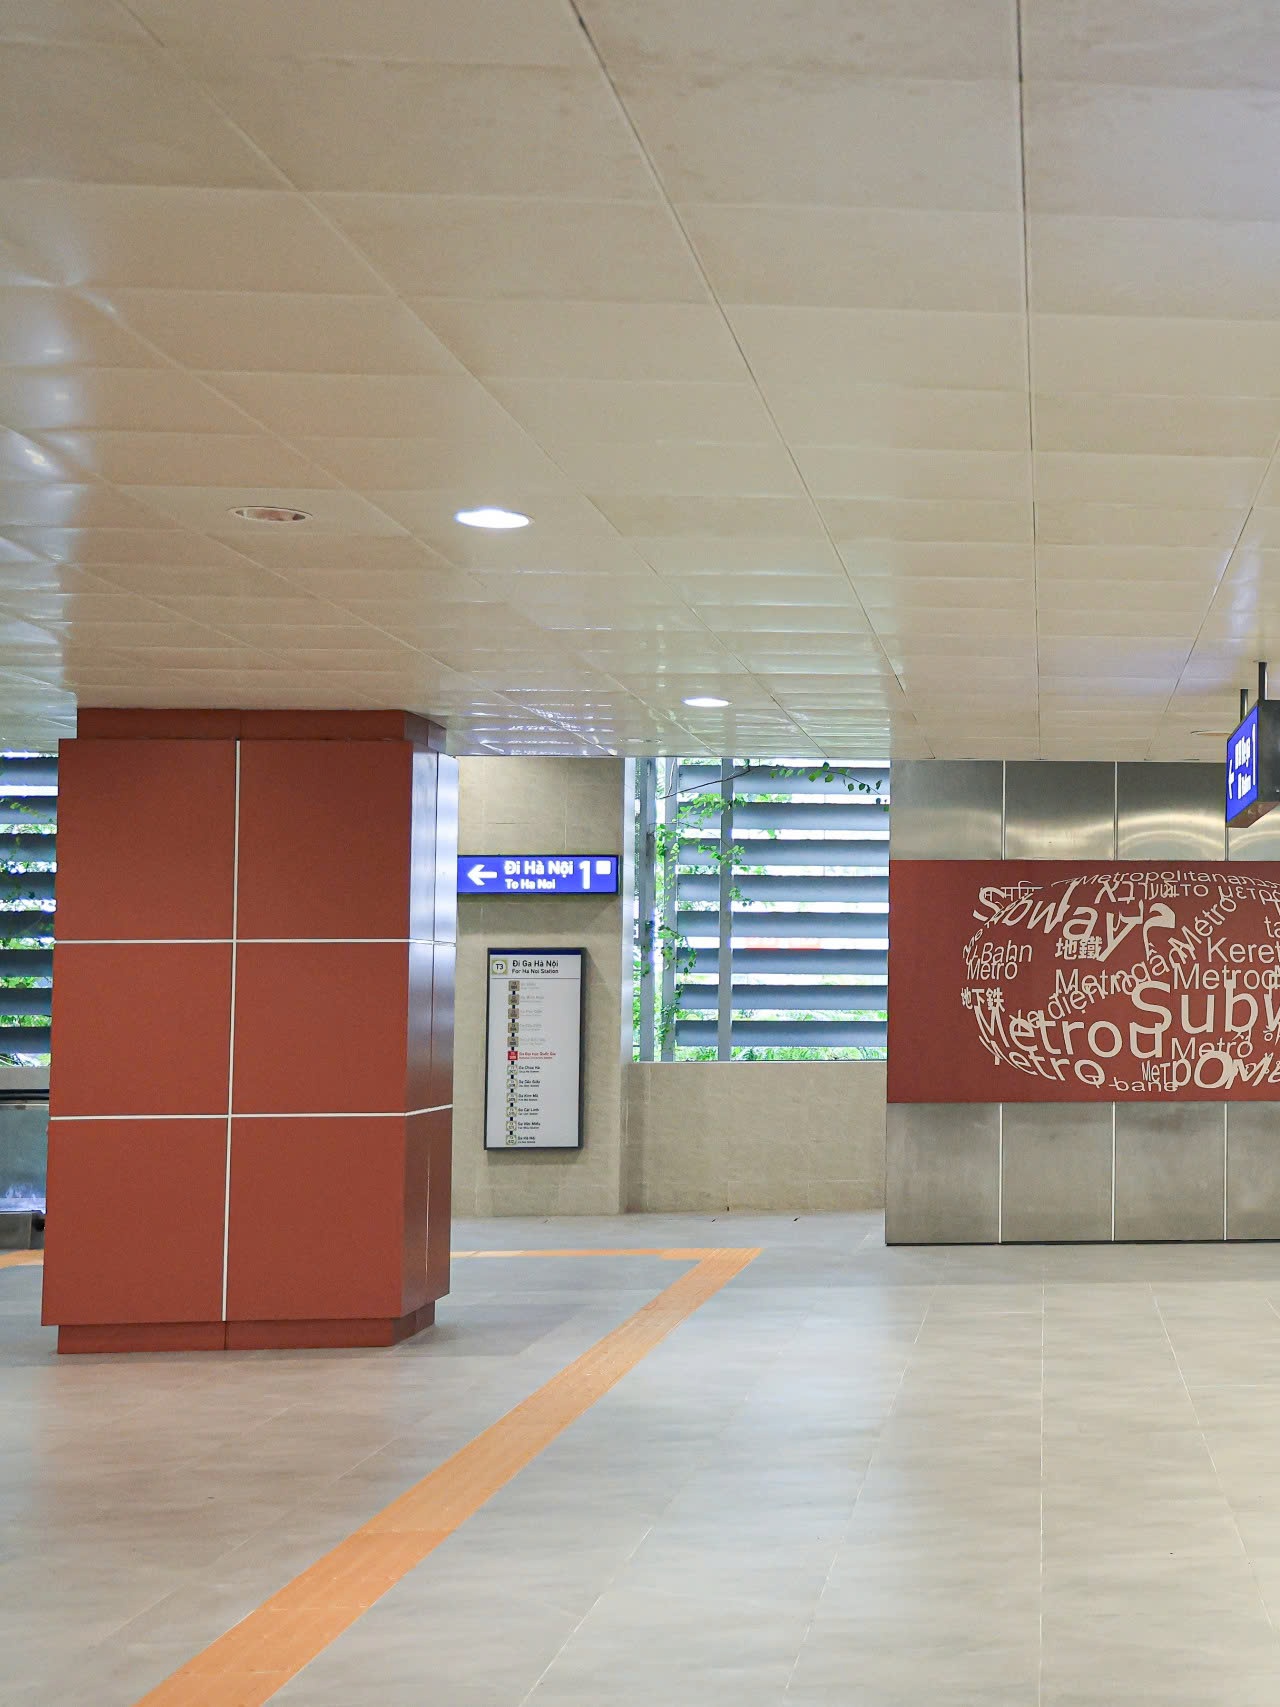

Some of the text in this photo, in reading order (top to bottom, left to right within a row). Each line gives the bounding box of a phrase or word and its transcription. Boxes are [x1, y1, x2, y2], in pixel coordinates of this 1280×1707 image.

[504, 860, 574, 878] Đi Hà Nội
[579, 860, 591, 889] 1
[505, 879, 556, 889] To Ha Noi
[546, 960, 558, 969] Nội
